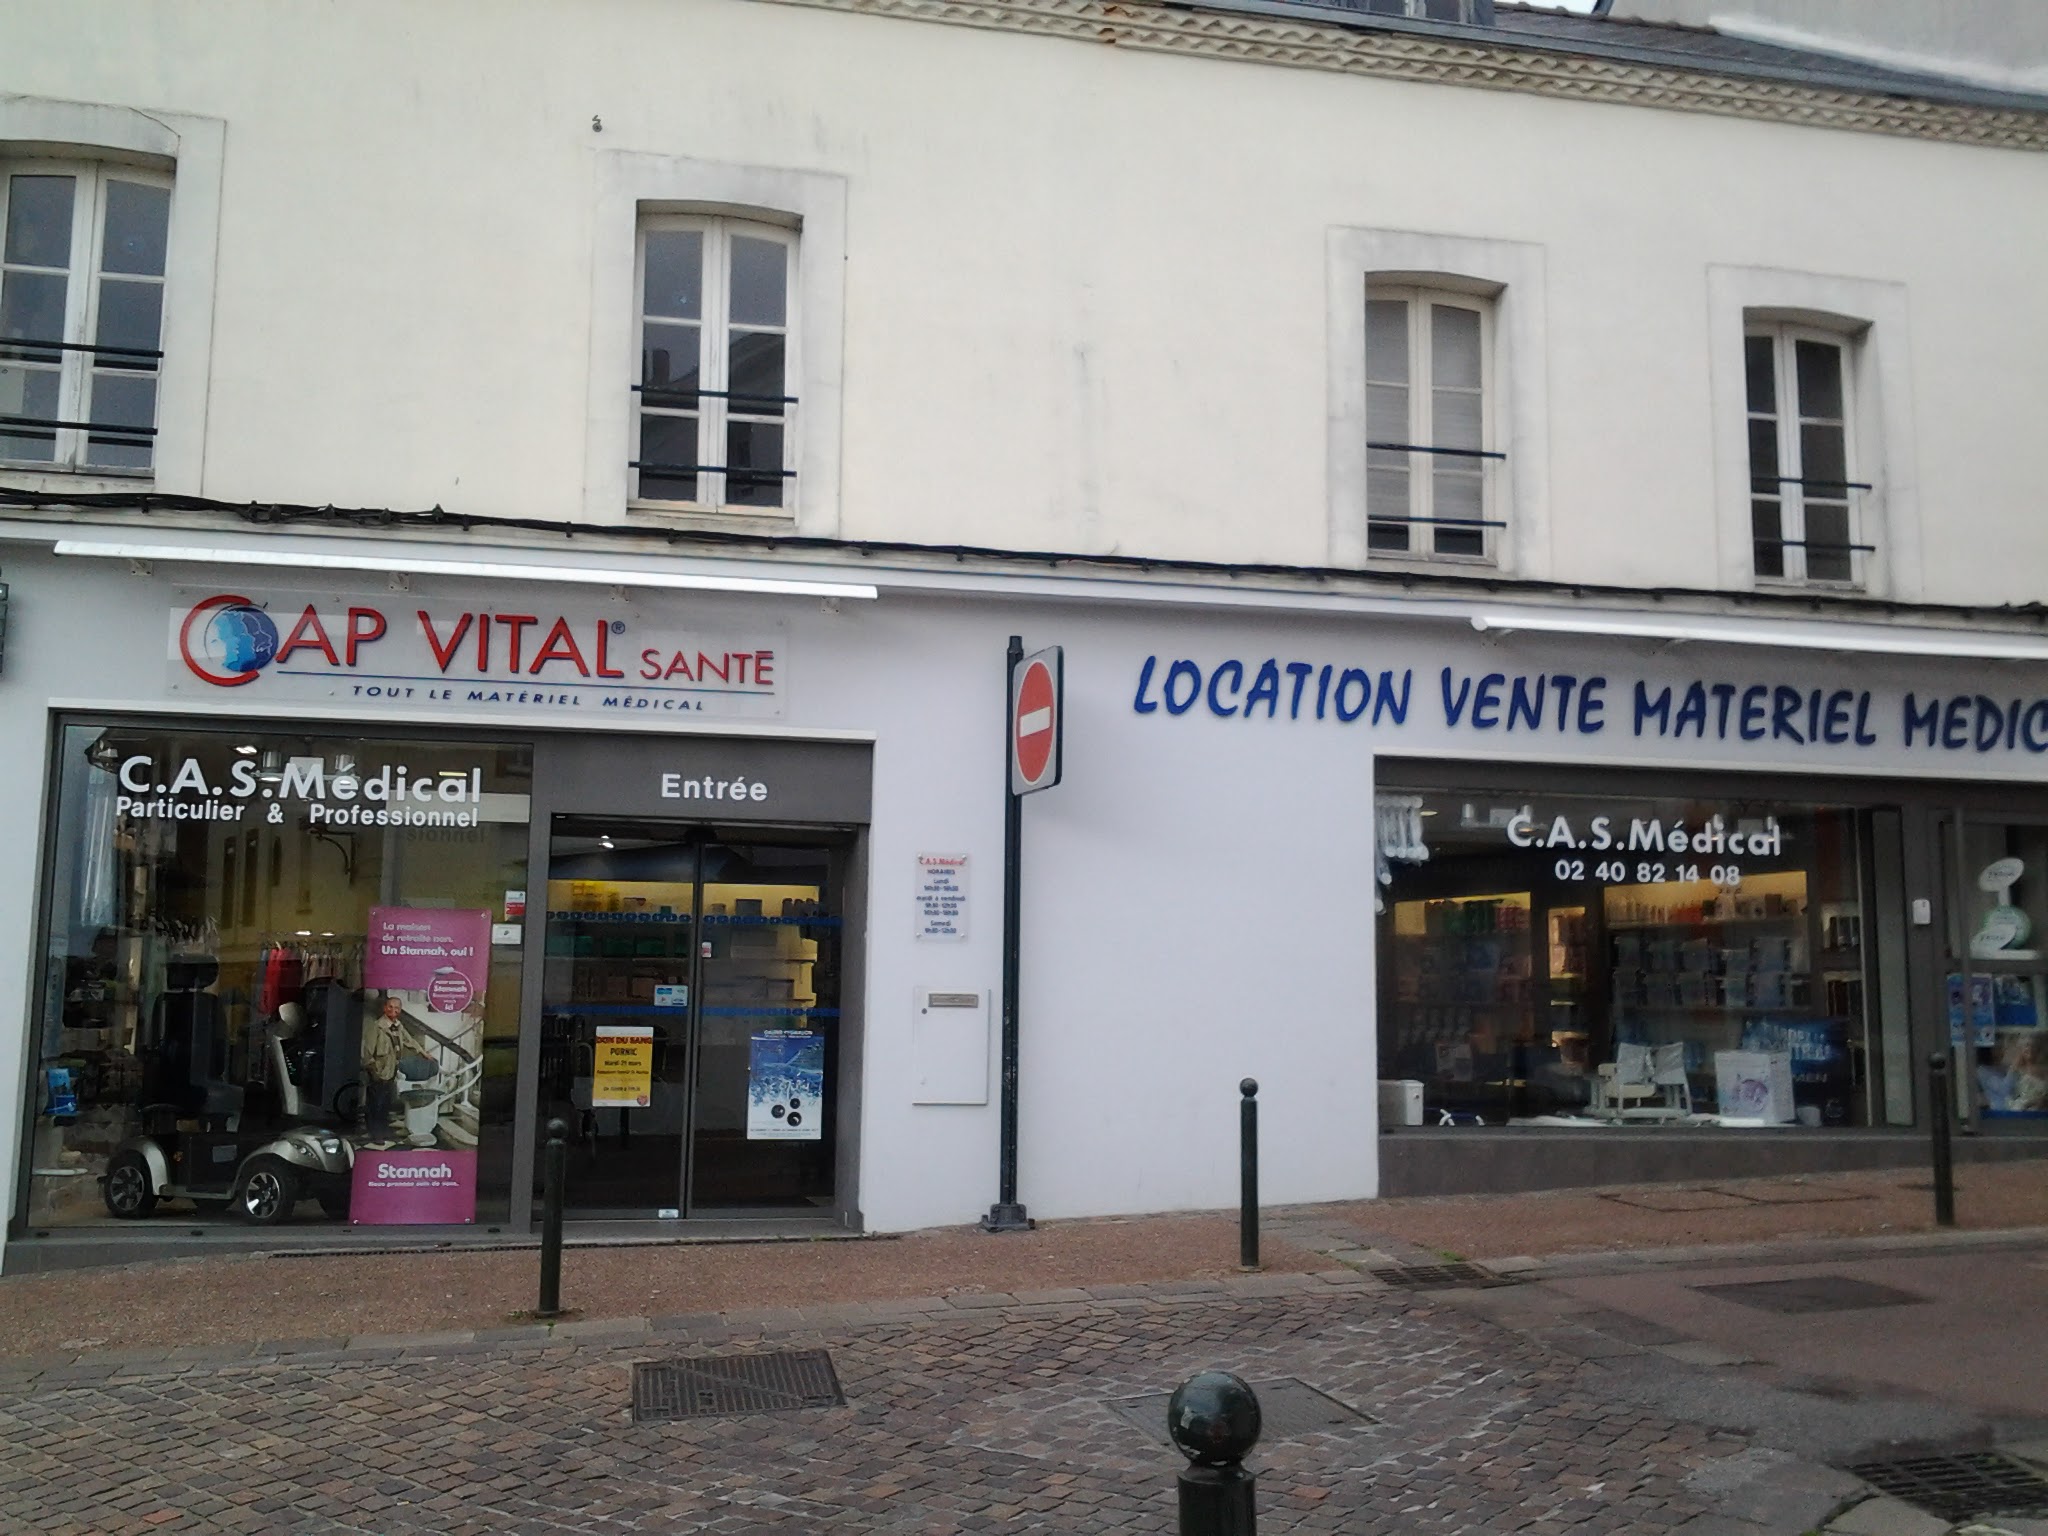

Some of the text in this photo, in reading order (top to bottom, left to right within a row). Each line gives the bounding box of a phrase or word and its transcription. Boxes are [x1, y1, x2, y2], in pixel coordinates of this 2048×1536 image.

[353, 685, 704, 712] TOUT LE MATÉRIEL MÉDICAL
[1132, 655, 1413, 727] LOCATION
[1440, 667, 1608, 734] VENTE
[1633, 680, 1877, 746] MATERIEL
[118, 755, 482, 804] C.A.S.Médical
[661, 773, 768, 802] Entrée
[116, 796, 480, 828] Particulier & Professionnel
[1506, 813, 1782, 857] C.A.S.Médical
[1555, 859, 1741, 886] 02 40 82 14 08
[382, 922, 394, 931] La
[382, 934, 394, 942] de
[396, 934, 432, 943] retraite
[381, 945, 397, 955] Un
[399, 945, 448, 957] Stannah,
[450, 948, 467, 957] oui
[377, 1163, 452, 1179] Stannah
